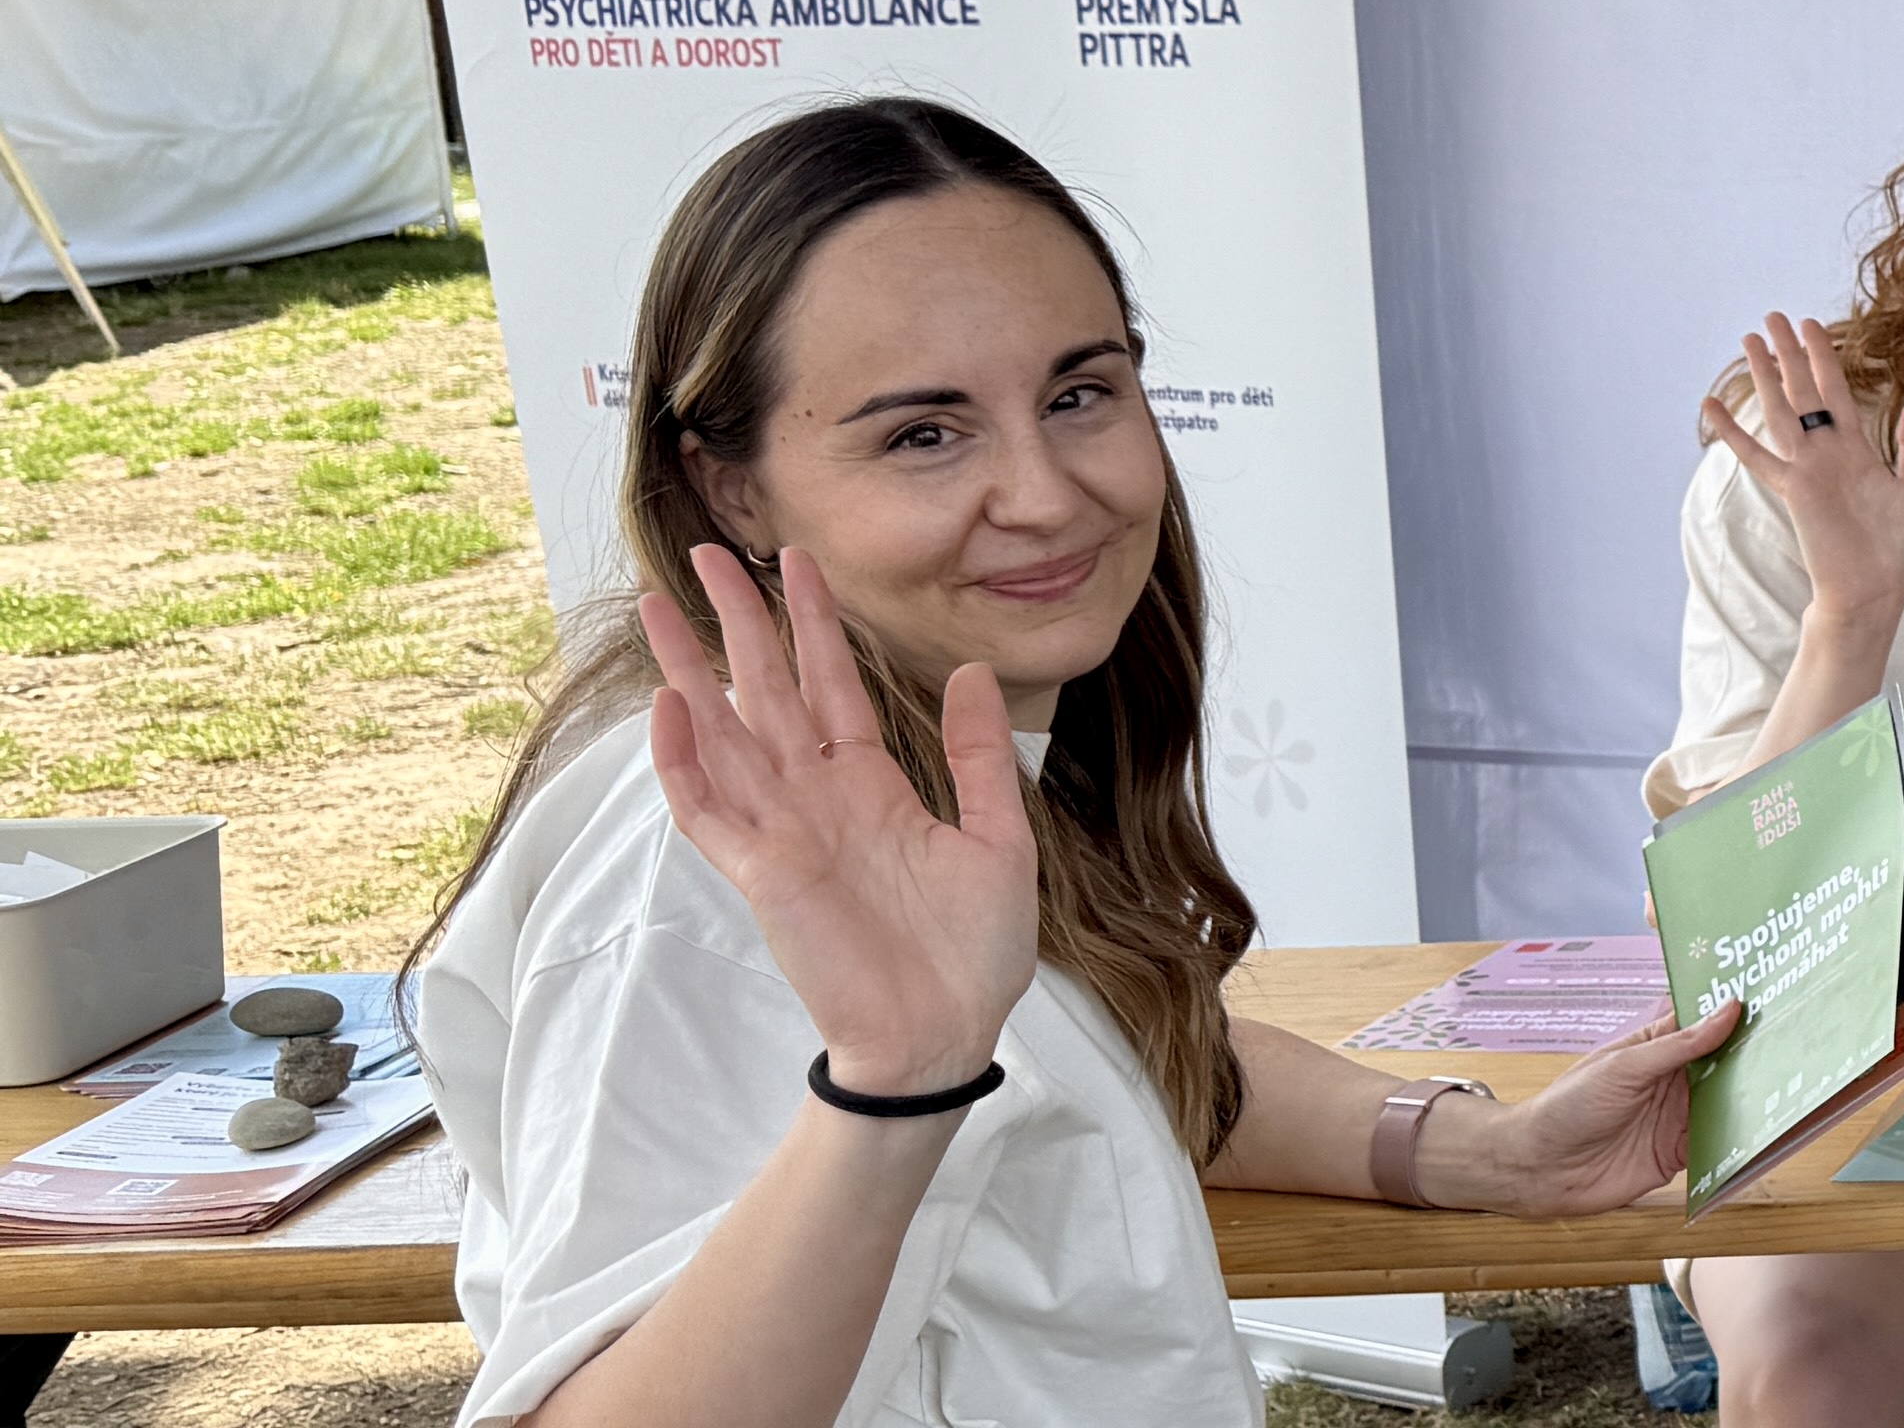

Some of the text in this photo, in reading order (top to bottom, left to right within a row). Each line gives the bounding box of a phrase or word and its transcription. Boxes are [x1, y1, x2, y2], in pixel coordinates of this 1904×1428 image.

[530, 28, 782, 68] PRO DĚTI A DOROST
[1079, 32, 1191, 68] PITTRA
[1148, 385, 1274, 409] entrum pro děti
[1749, 785, 1784, 816] ZAH
[1753, 796, 1798, 832] RADA
[1763, 811, 1802, 847] DUŠI
[1714, 865, 1861, 969] Spojujeme,
[1698, 927, 1812, 1016] abychom
[1820, 858, 1889, 933] mohli
[1746, 922, 1850, 1025] pomáhat
